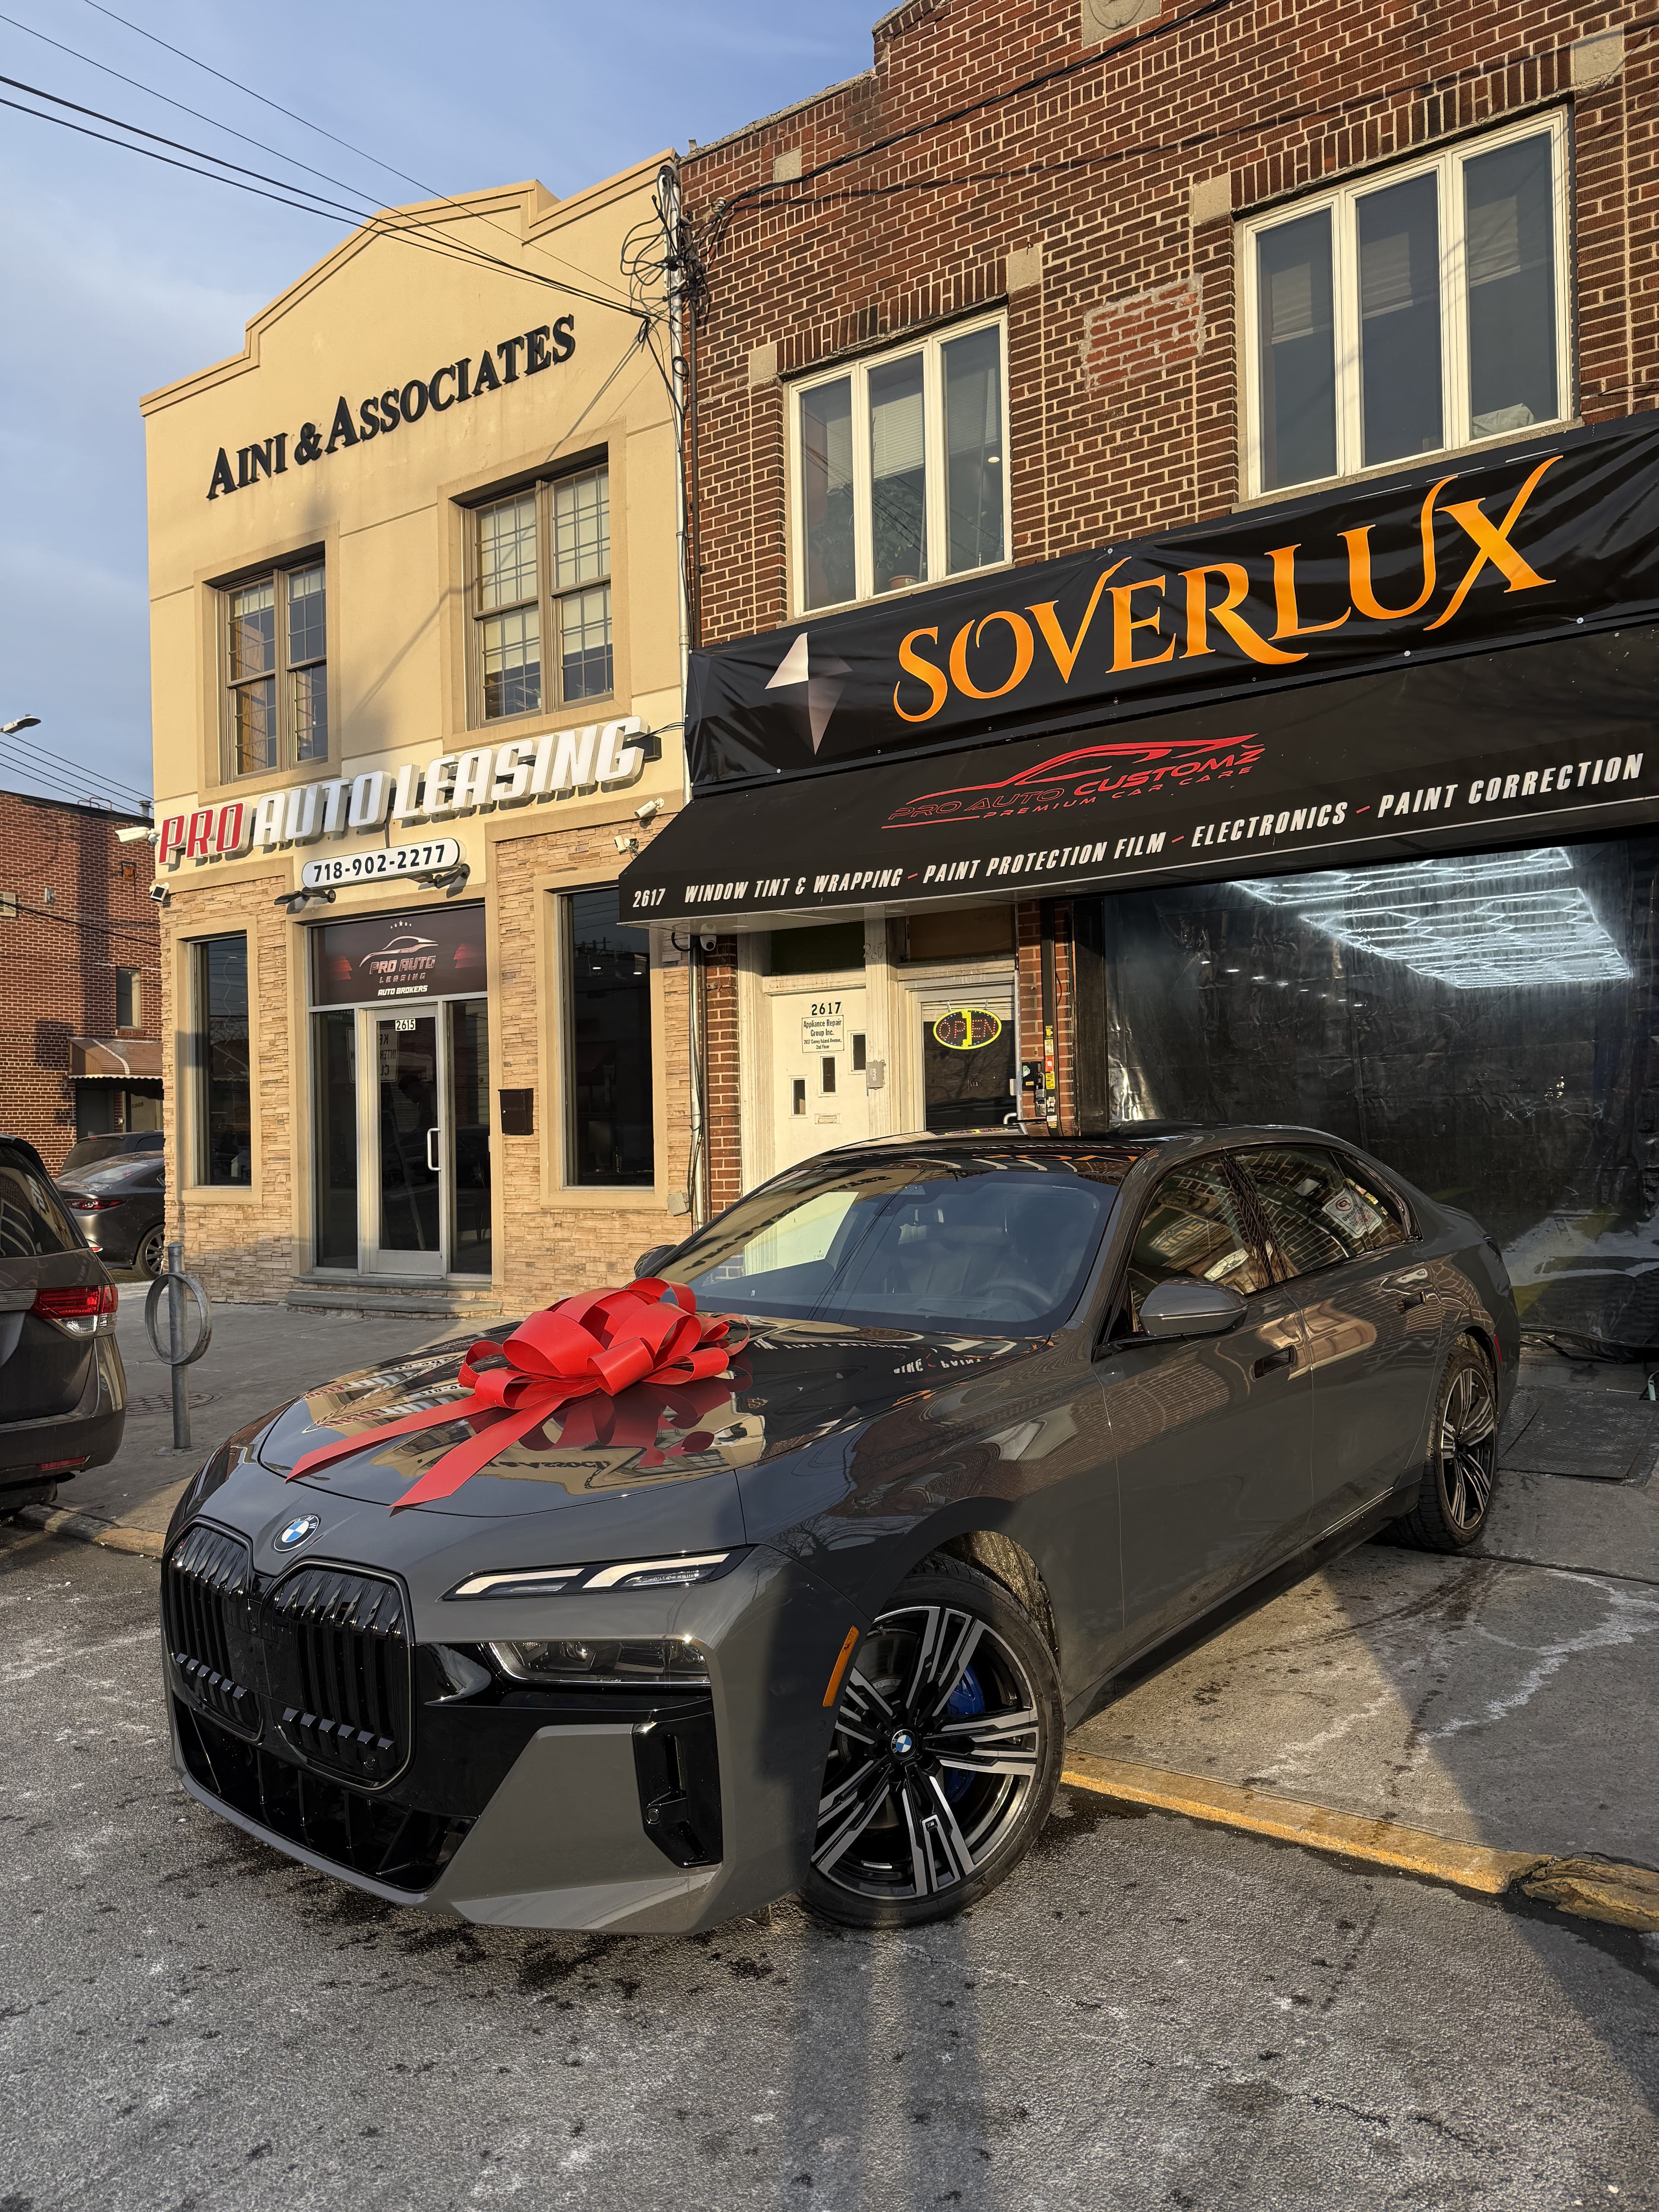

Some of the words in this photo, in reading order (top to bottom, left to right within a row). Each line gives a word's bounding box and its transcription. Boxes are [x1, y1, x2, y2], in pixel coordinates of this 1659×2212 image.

[294, 422, 323, 465] &
[893, 455, 1564, 722] SOVERLUX
[159, 802, 254, 865] PRO
[253, 771, 391, 847] AUTO
[393, 715, 649, 820] LEASING
[983, 797, 1096, 819] PREMIUM
[1112, 784, 1163, 799] CAR
[1179, 766, 1254, 787] CARE
[888, 801, 962, 820] PRO
[964, 788, 1065, 812] AUTO
[684, 881, 749, 903] WINDOW
[753, 877, 791, 898] TINT
[795, 877, 806, 895] &
[813, 868, 904, 893] WRAPPING
[922, 860, 981, 884] PAINT
[985, 841, 1107, 877] PROTECTION
[1114, 832, 1166, 859] FILM
[1191, 801, 1348, 848] ELECTRONICS
[1377, 783, 1458, 818] PAINT
[1468, 753, 1643, 805] CORRECTION
[313, 844, 445, 880] 718-902-2277
[632, 888, 666, 908] 2617
[369, 960, 397, 974] PRO
[399, 956, 436, 971] AUTO
[379, 973, 426, 984] LEASING
[378, 988, 395, 996] AUTO
[396, 985, 428, 994] BROKERS
[811, 1001, 842, 1015] 2617
[396, 1019, 415, 1030] 2615
[804, 1020, 825, 1029] Appliance
[826, 1018, 842, 1027] Repair
[938, 1019, 996, 1040] OPEN
